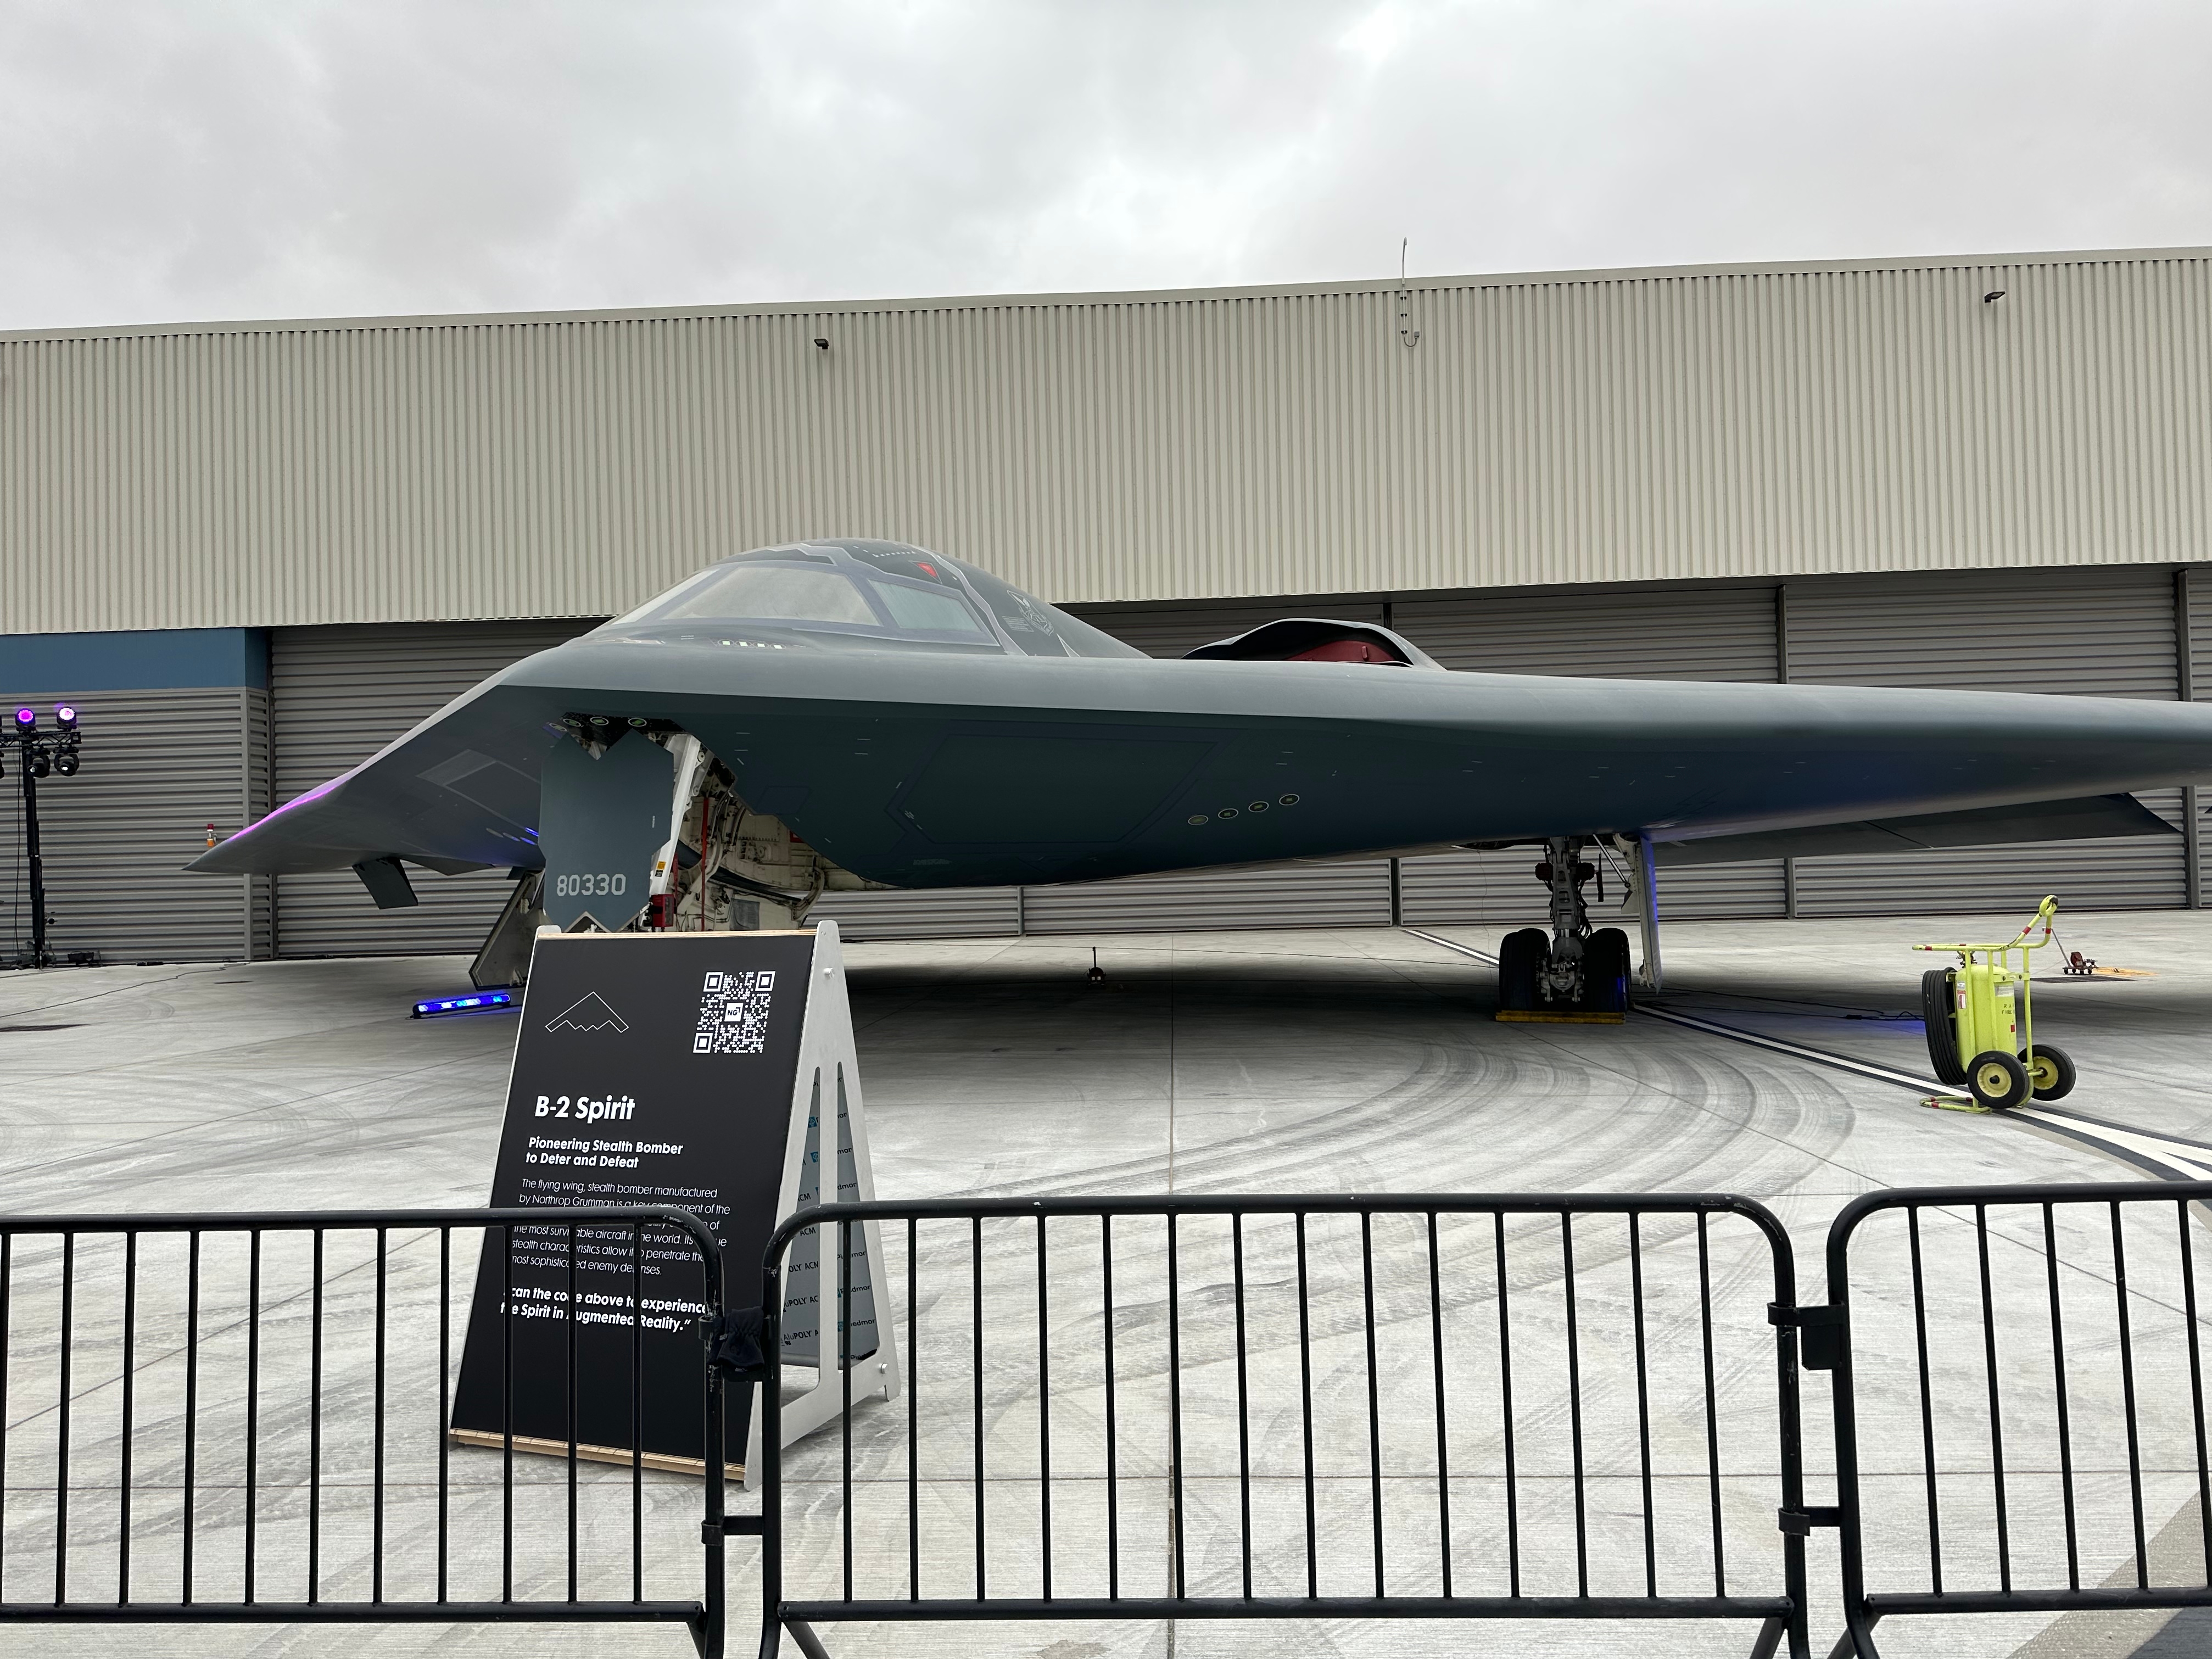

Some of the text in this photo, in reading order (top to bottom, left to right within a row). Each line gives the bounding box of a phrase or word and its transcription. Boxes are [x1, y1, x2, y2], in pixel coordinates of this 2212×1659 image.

[556, 873, 626, 897] 80330
[534, 1094, 635, 1124] B-2 Spirit
[528, 1136, 684, 1154] Pioneering Stealth Bomber
[526, 1152, 639, 1169] to Deter and Defeat
[522, 1178, 718, 1198] The flying wing, stealth bomber manufactured
[519, 1193, 532, 1205] by
[532, 1194, 571, 1207] Northrop
[572, 1197, 615, 1208] Grumman
[704, 1204, 716, 1214] of
[715, 1205, 730, 1215] the
[710, 1220, 720, 1230] of
[528, 1226, 549, 1235] most
[595, 1230, 627, 1239] aircraft
[653, 1234, 682, 1244] world.
[512, 1239, 538, 1249] stealth
[602, 1245, 628, 1257] allow
[645, 1249, 690, 1260] penetrate
[588, 1261, 619, 1274] enemy
[533, 1288, 551, 1300] the
[585, 1293, 623, 1306] above
[521, 1304, 551, 1319] Spirit
[552, 1305, 564, 1319] in
